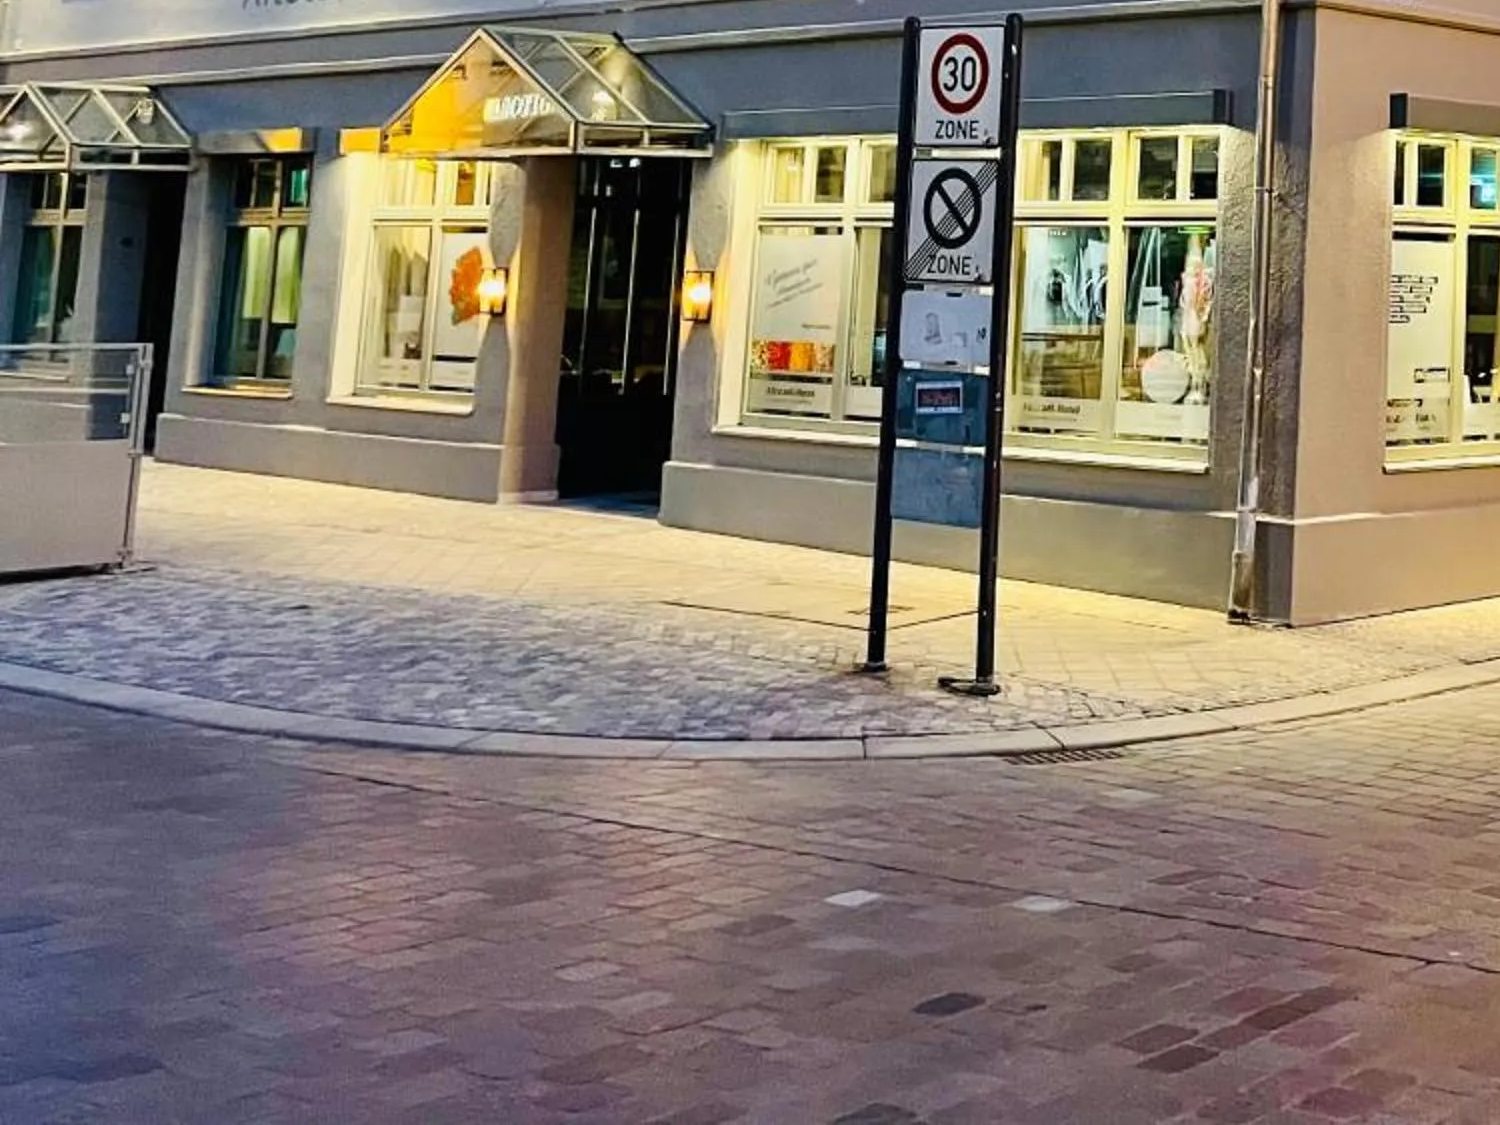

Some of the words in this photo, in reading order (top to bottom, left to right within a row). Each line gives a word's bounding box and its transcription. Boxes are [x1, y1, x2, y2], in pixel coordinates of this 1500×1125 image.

[942, 56, 977, 92] 30
[934, 119, 980, 140] ZONE
[926, 254, 973, 276] ZONE
